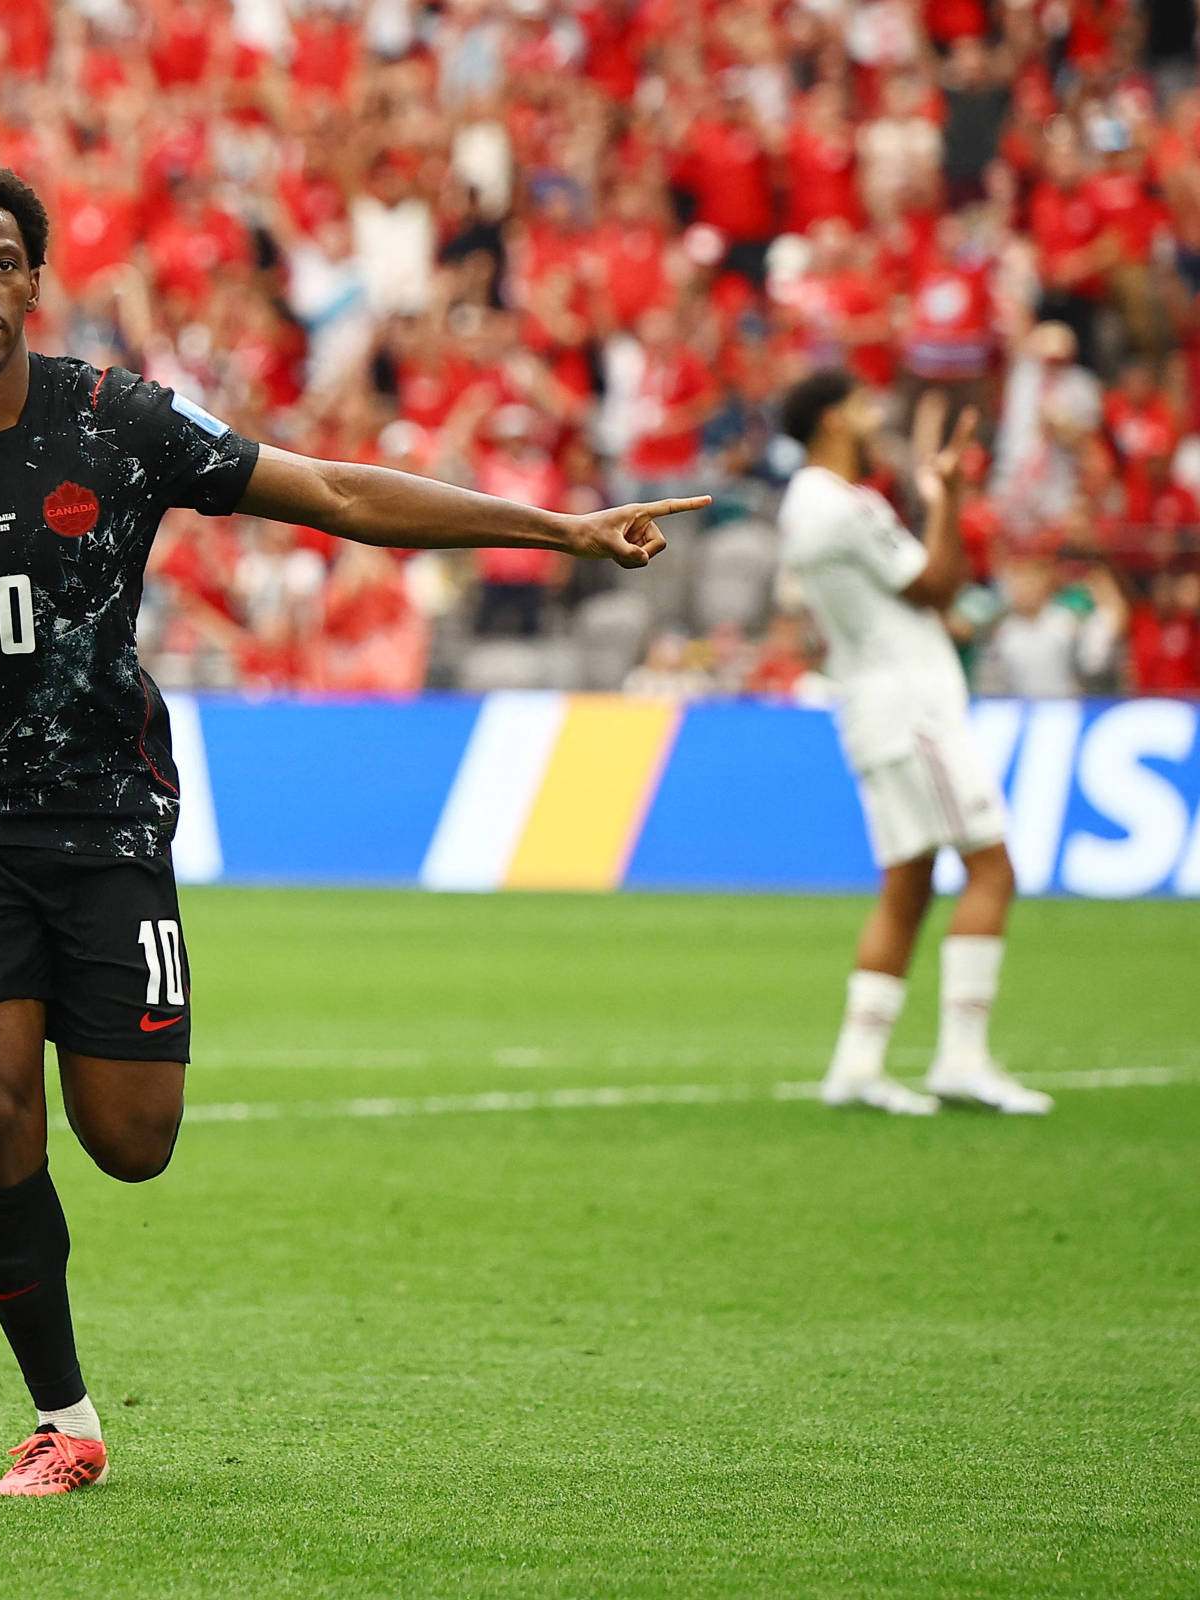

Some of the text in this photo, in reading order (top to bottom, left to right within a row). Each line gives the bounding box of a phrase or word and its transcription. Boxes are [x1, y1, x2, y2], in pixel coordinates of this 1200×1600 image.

[47, 503, 96, 517] CANADA
[930, 697, 1200, 898] IS
[138, 920, 185, 1006] 10
